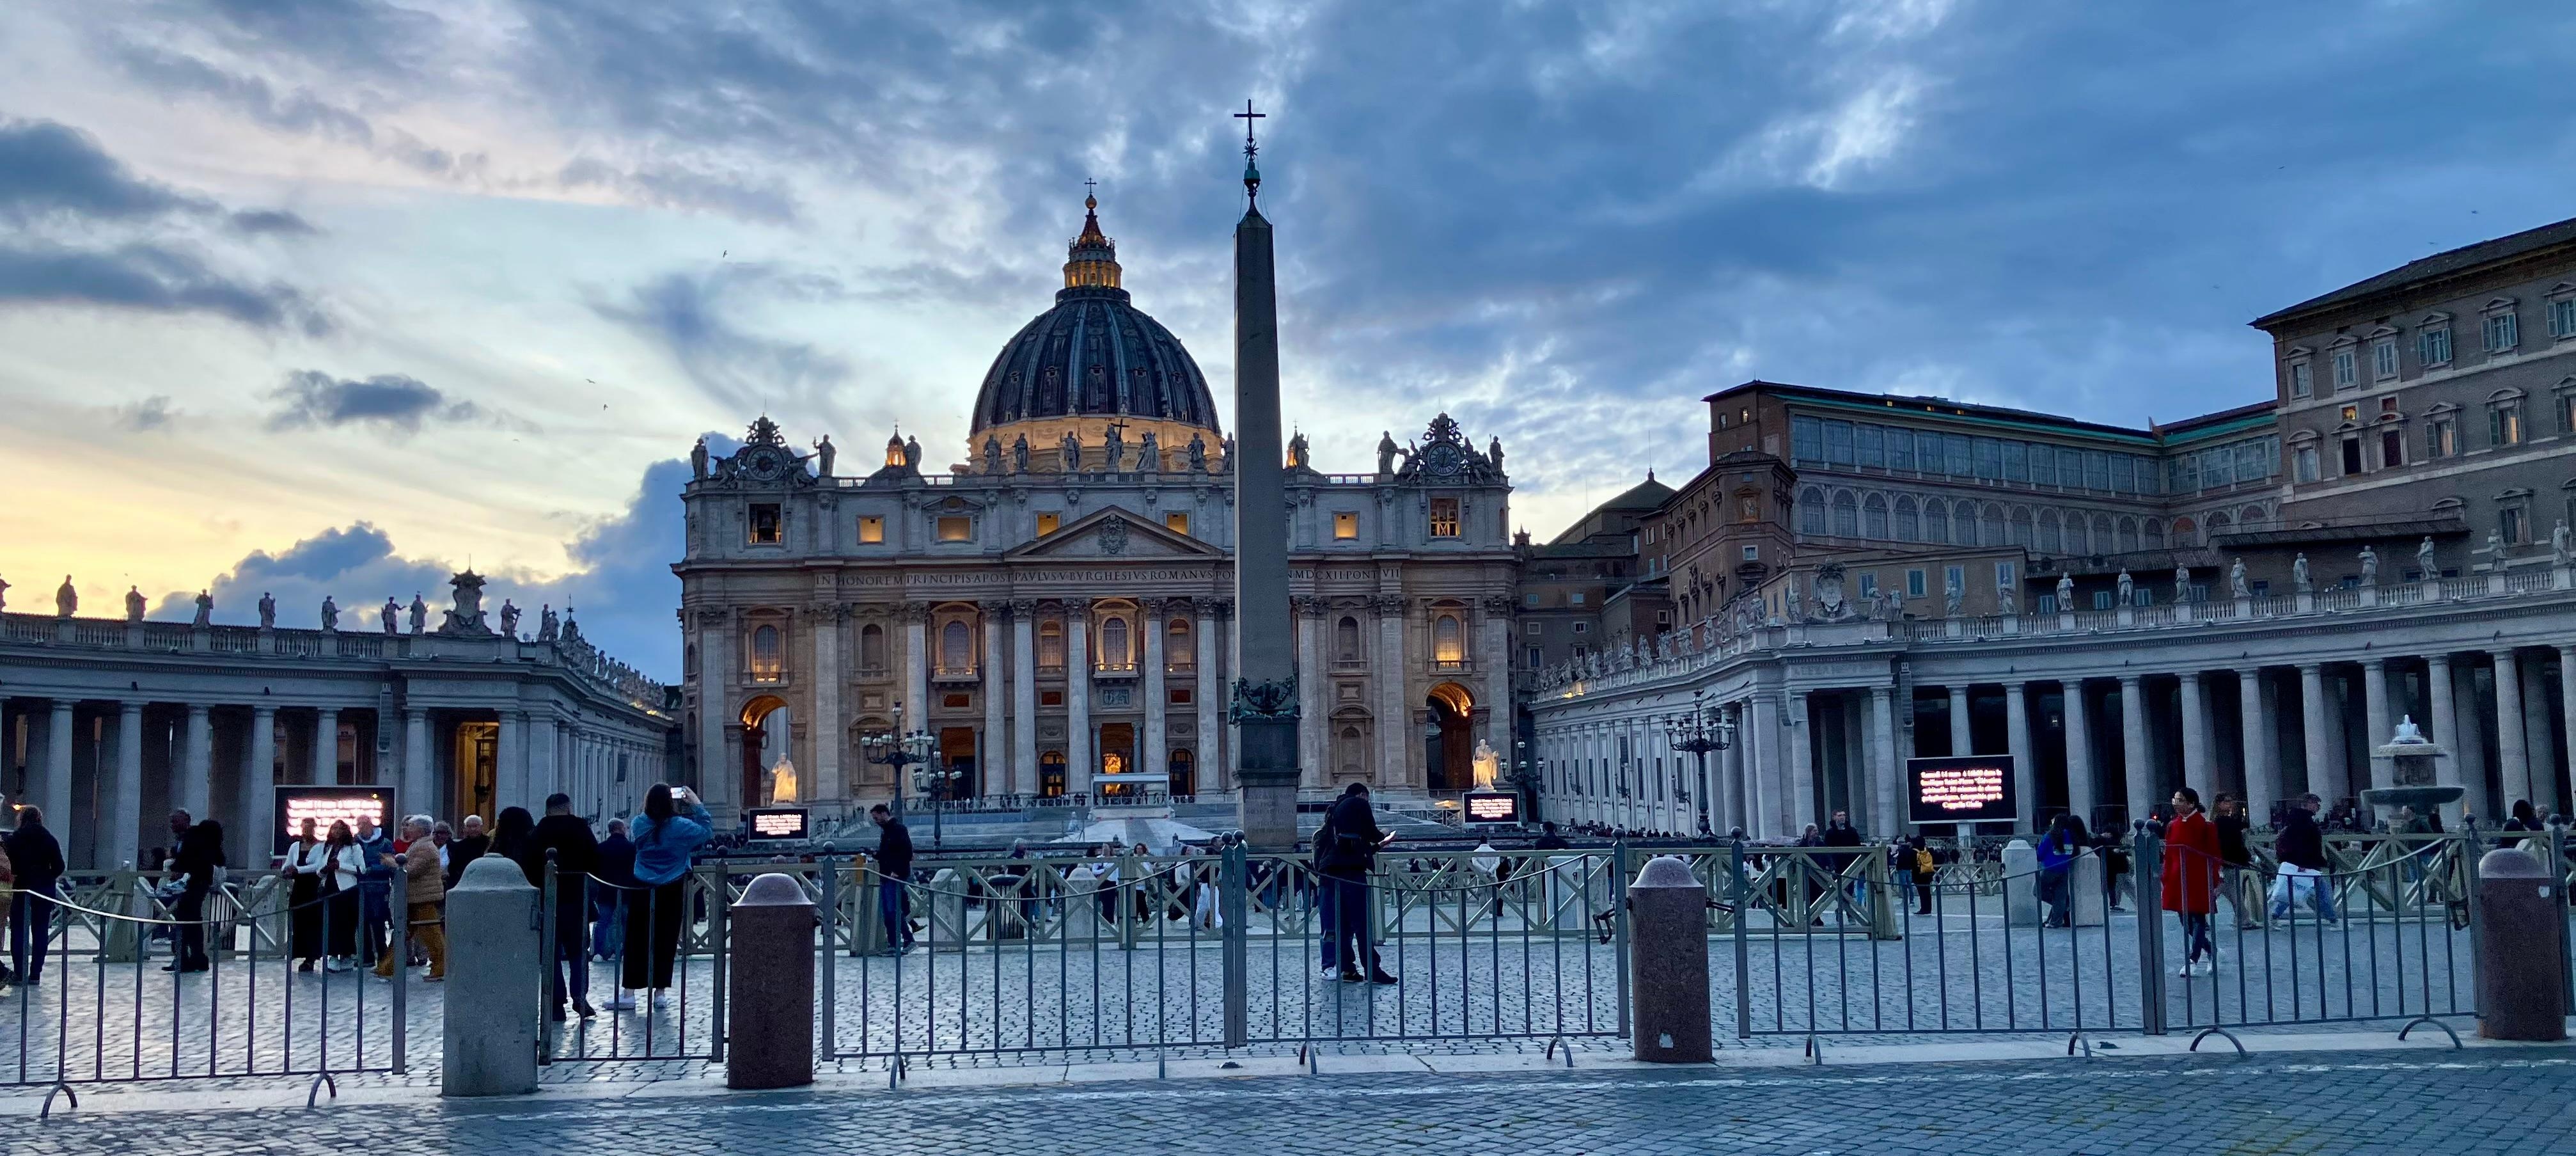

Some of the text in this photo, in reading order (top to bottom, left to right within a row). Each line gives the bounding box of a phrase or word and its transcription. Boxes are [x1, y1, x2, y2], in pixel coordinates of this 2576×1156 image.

[817, 574, 831, 584] IN
[837, 576, 903, 585] HONOREM
[906, 574, 971, 584] PRINCIPIS
[1015, 572, 1056, 582] PAVLVS
[1150, 571, 1213, 580] ROMANVS
[1346, 569, 1377, 580] PONT
[1382, 569, 1399, 578] VII
